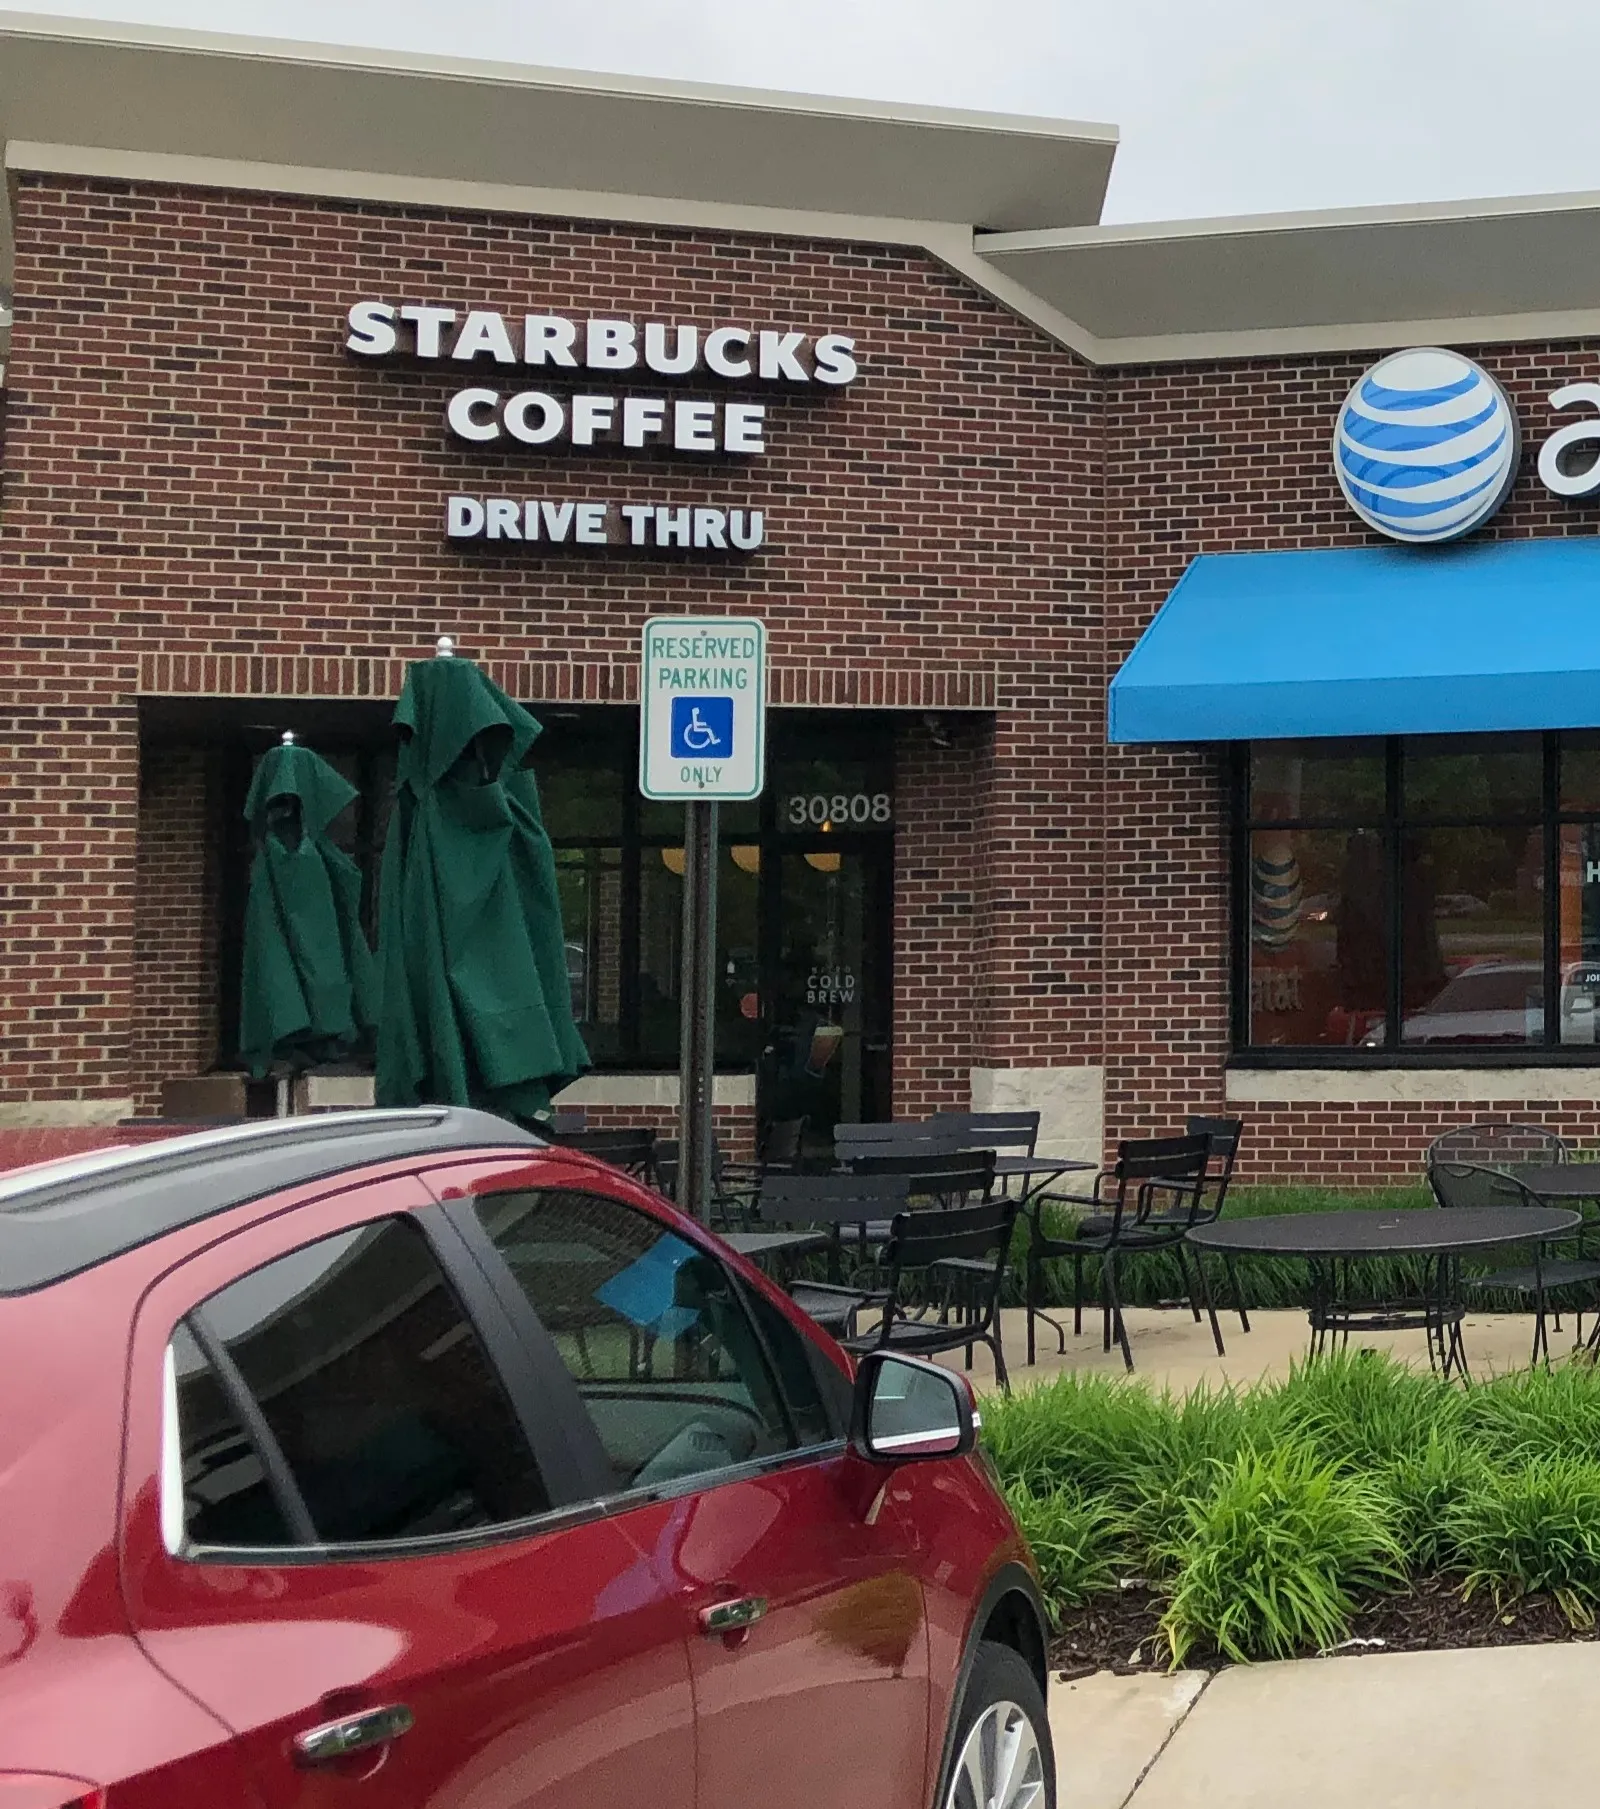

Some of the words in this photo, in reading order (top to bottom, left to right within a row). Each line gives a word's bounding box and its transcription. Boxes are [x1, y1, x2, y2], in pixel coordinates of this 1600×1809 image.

[345, 301, 858, 384] STARBUCKS
[447, 388, 766, 454] COFFEE
[446, 497, 607, 544] DRIVE
[622, 505, 764, 550] THRU
[651, 637, 755, 659] RESERVED
[658, 667, 748, 690] PARKING
[680, 766, 723, 784] ONLY
[788, 794, 891, 825] 30808
[807, 975, 855, 989] COLD
[807, 990, 854, 1003] BREW
